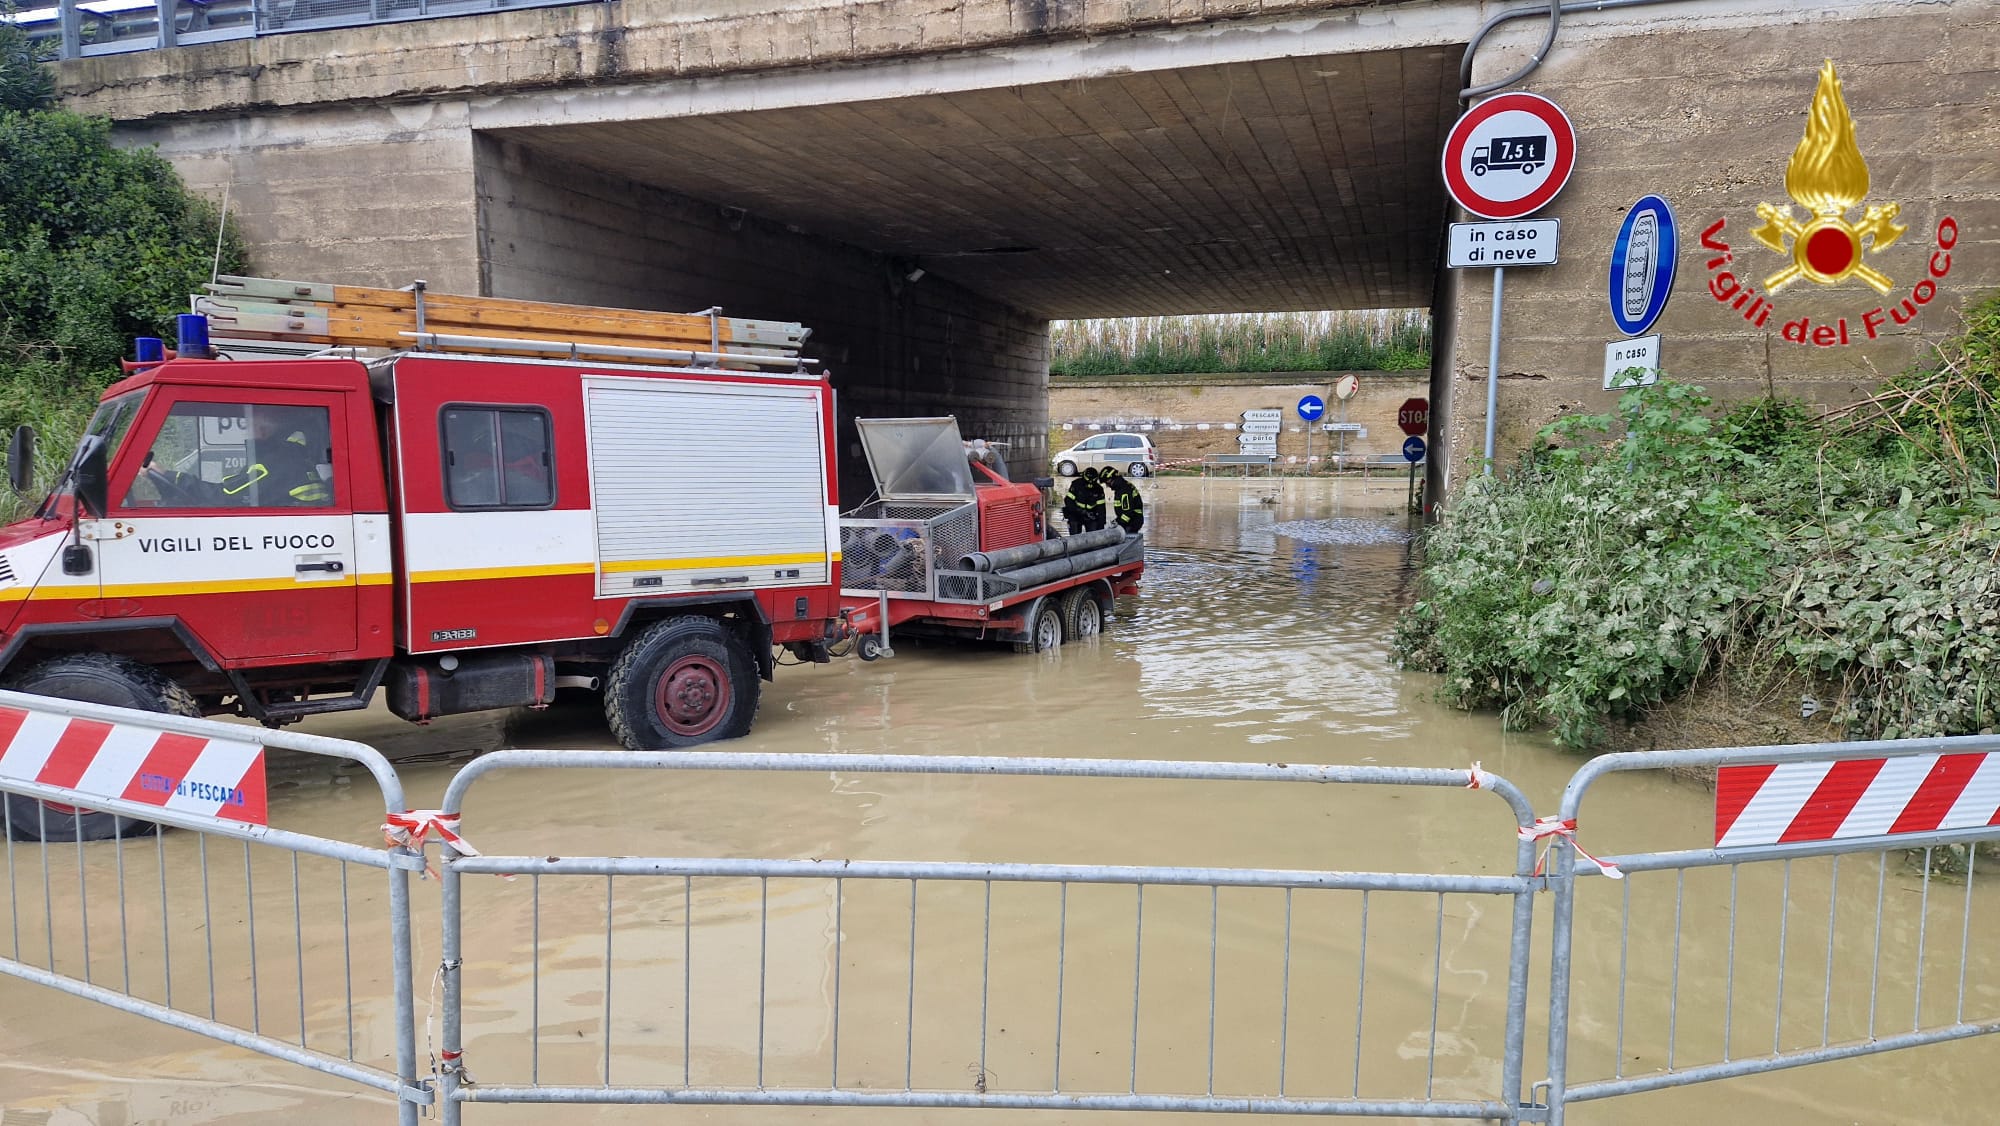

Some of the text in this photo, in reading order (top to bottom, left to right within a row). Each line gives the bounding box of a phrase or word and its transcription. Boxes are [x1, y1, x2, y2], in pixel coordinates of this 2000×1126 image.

[1501, 141, 1535, 160] 7,5 t
[1470, 228, 1538, 242] in caso
[1468, 247, 1537, 261] di neve
[1615, 347, 1647, 361] in caso
[139, 534, 335, 553] VIGILI DEL FUOCO
[177, 780, 187, 796] di
[191, 782, 244, 806] PESCARA
